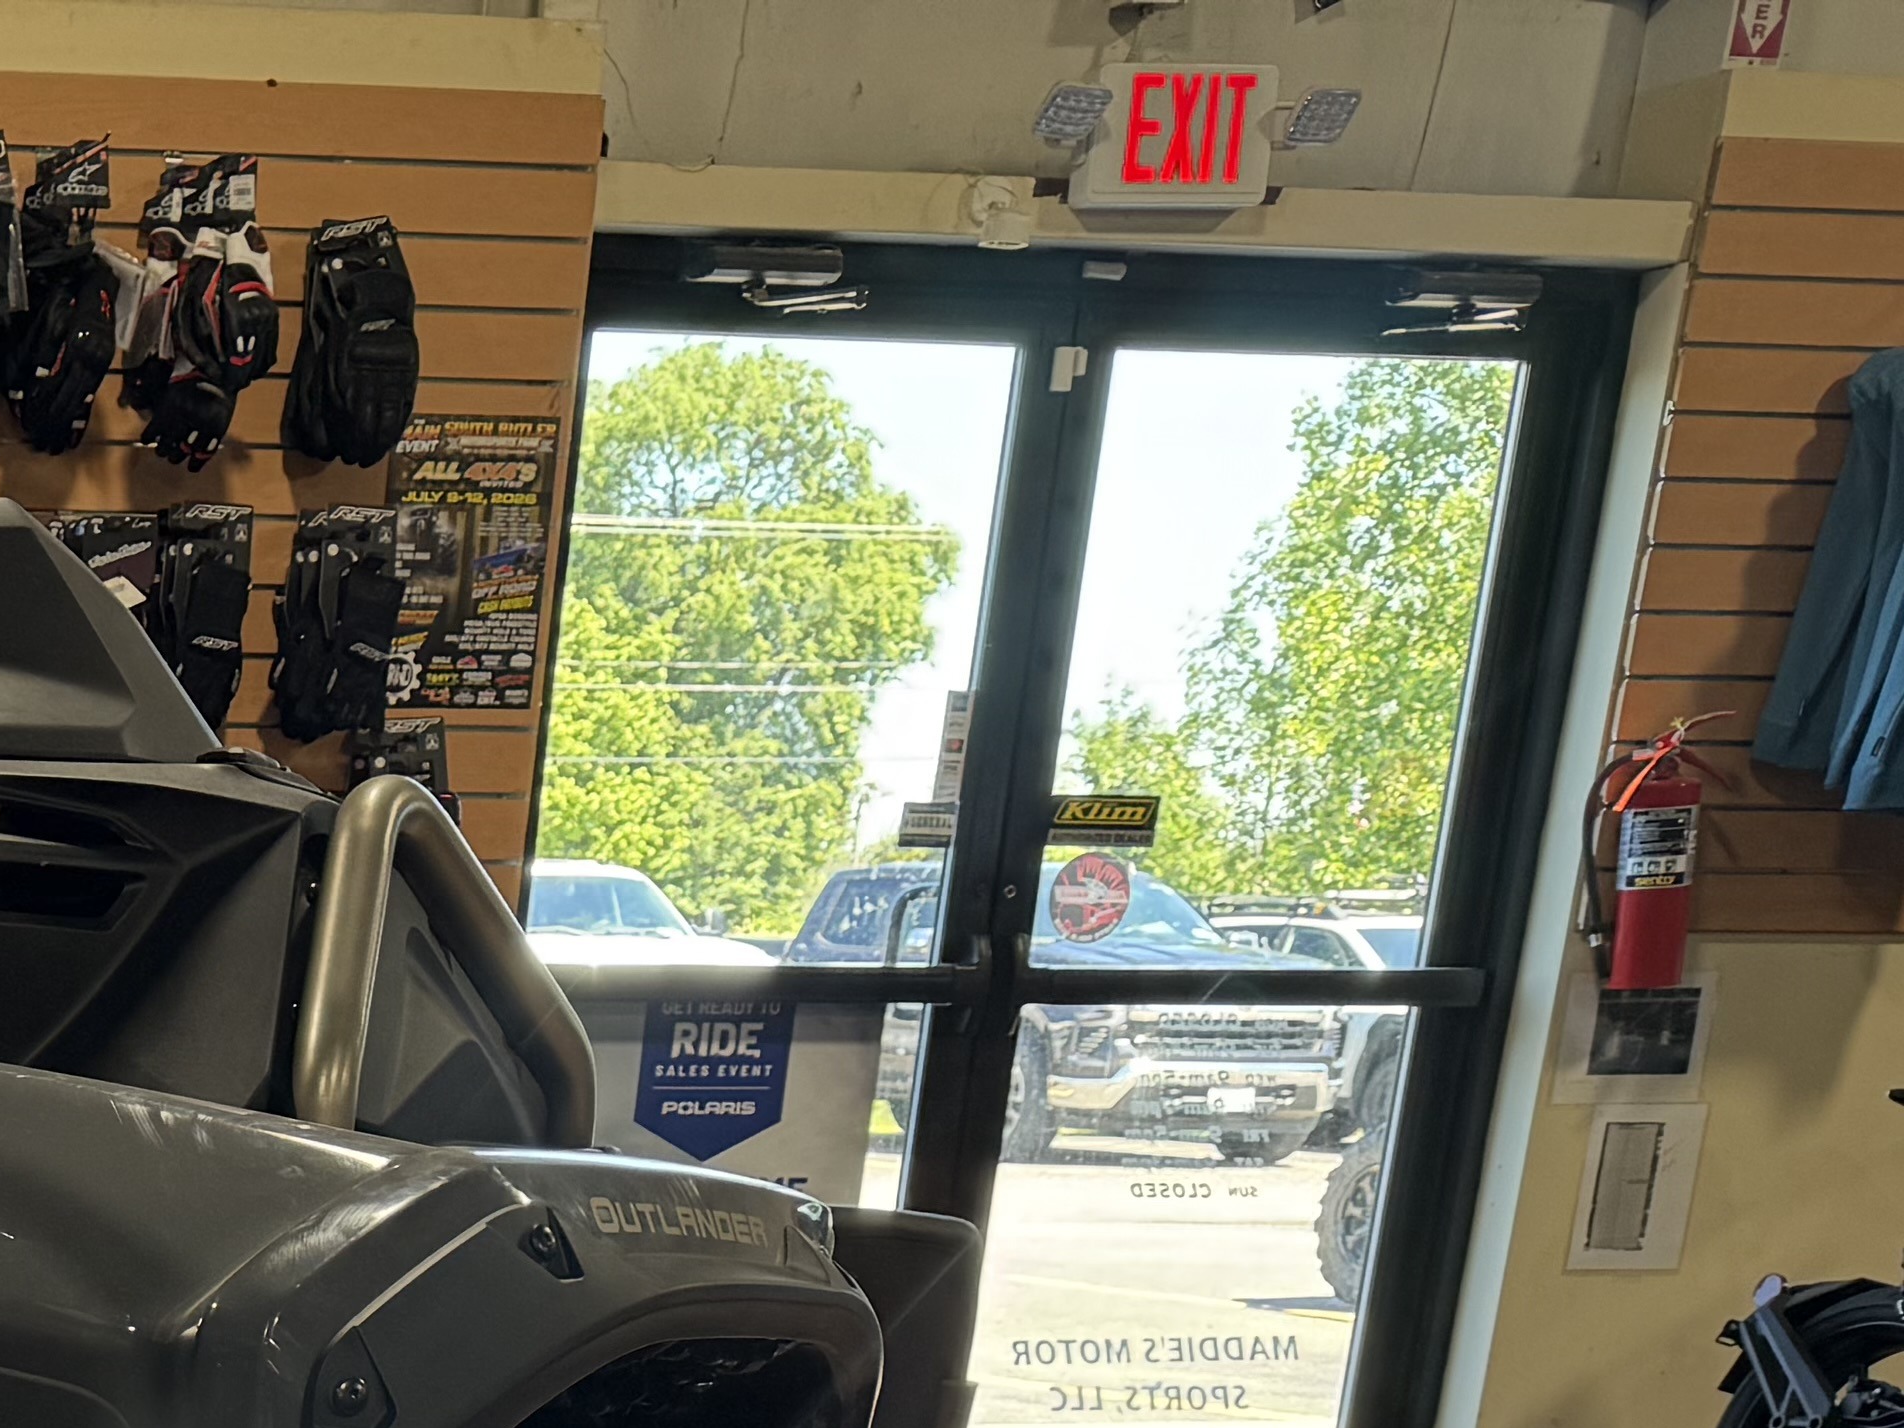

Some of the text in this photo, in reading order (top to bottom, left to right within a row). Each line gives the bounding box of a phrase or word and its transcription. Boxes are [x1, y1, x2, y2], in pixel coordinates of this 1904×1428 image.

[1122, 72, 1259, 184] EXIT
[413, 461, 461, 480] ALL
[401, 491, 444, 502] JULY
[186, 504, 253, 520] RST
[330, 506, 396, 523] RST
[1060, 801, 1147, 821] Klim
[671, 1021, 765, 1058] RIDE
[655, 1064, 773, 1077] SALES EVENT
[661, 1101, 757, 1115] POLARIS
[589, 1196, 769, 1247] OUTLANDER
